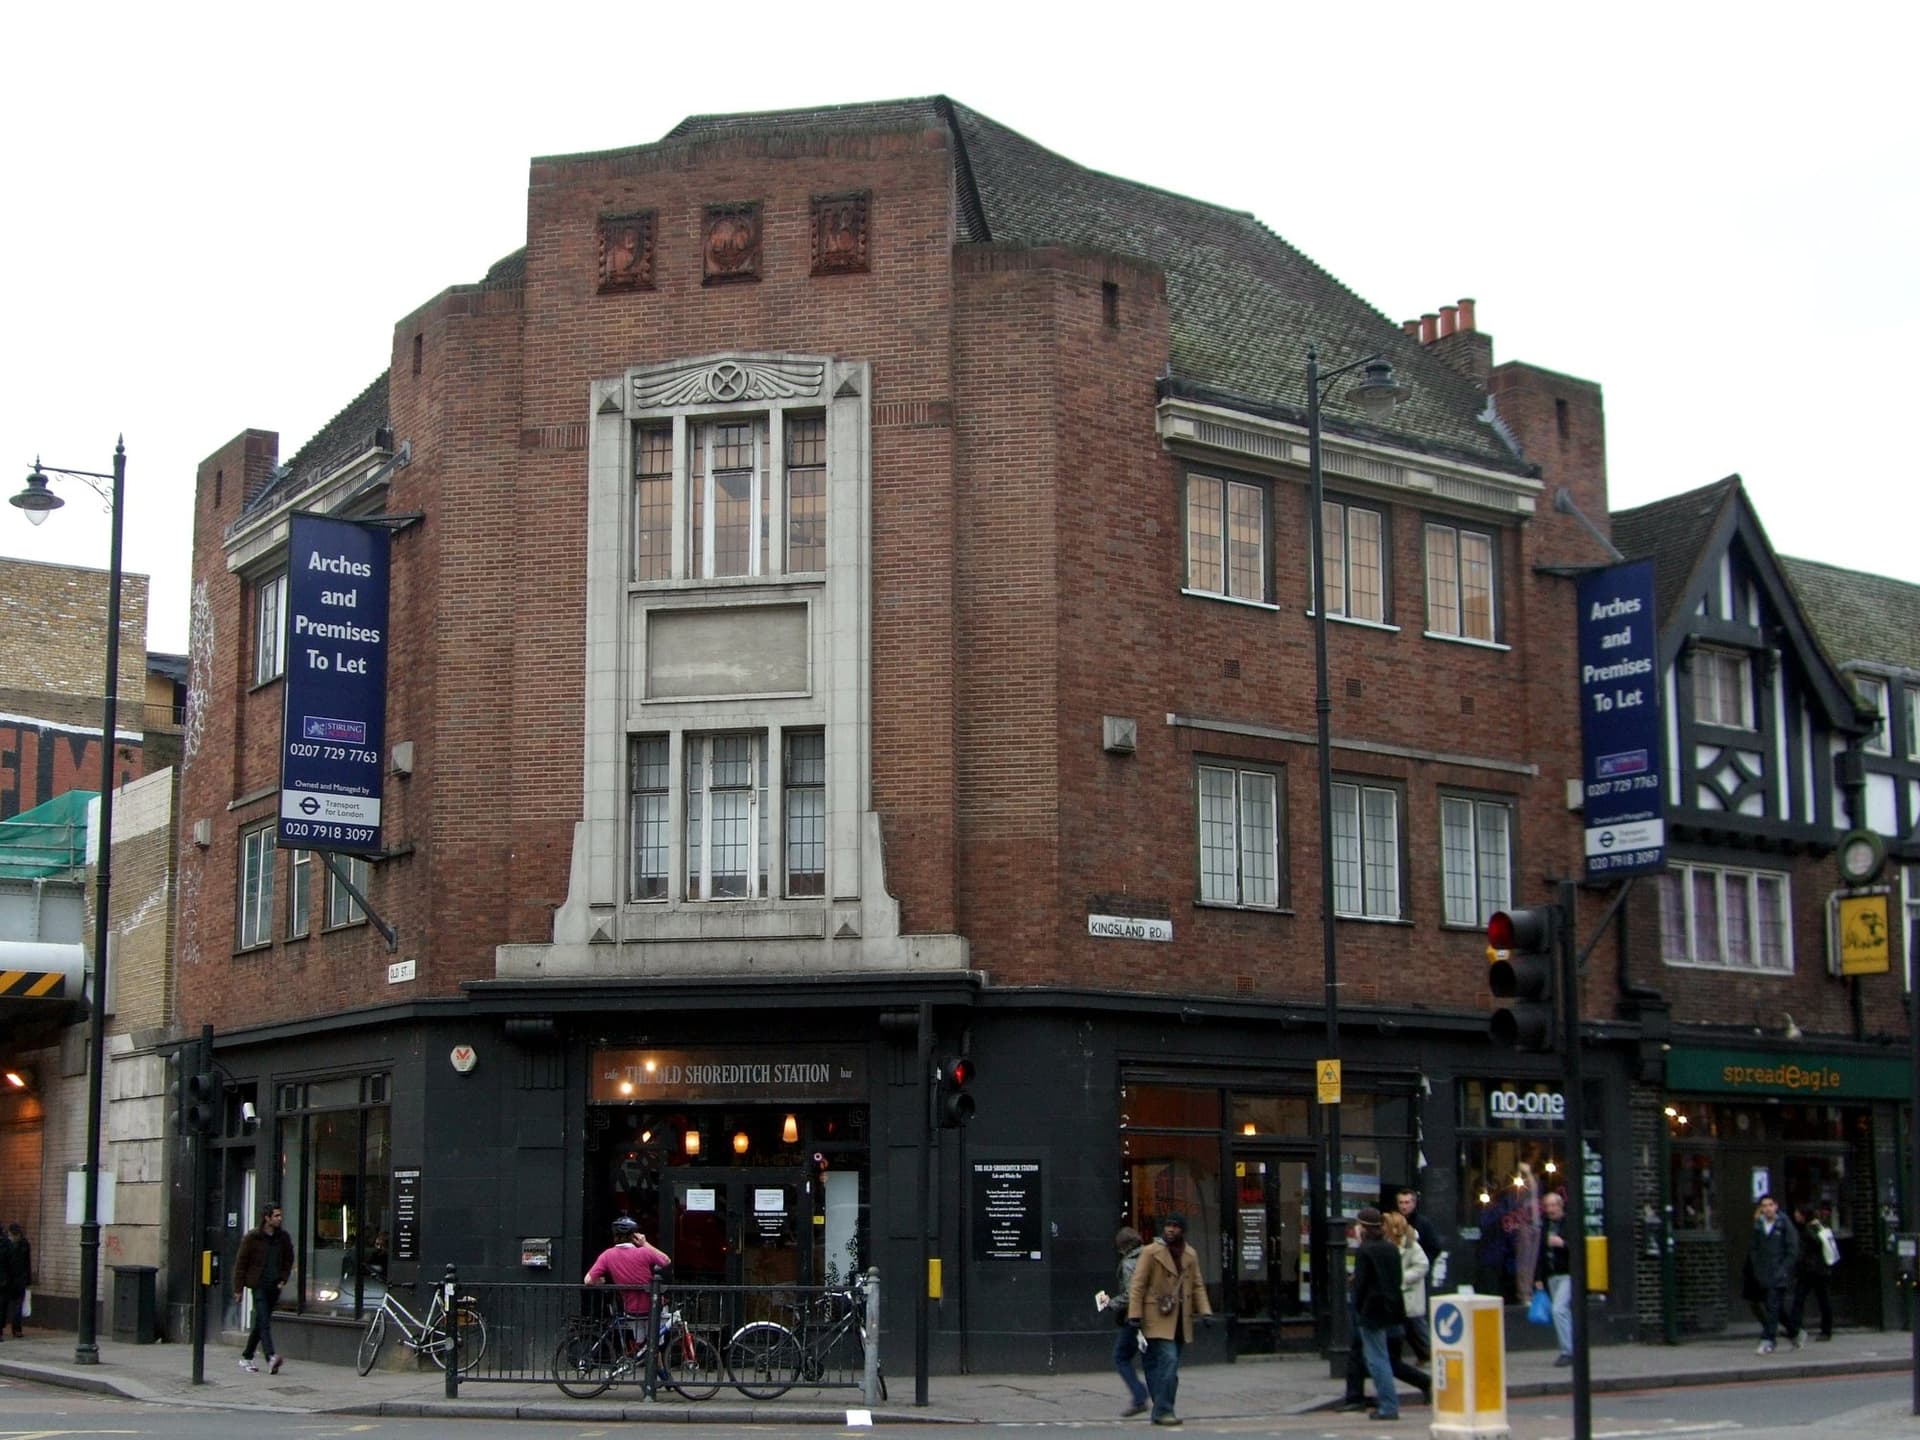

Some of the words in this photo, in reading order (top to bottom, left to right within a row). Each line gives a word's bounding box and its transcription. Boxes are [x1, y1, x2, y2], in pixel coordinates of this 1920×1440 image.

[308, 551, 372, 577] Arches
[320, 589, 357, 608] and
[1591, 597, 1641, 621] Arches
[295, 614, 380, 643] Premises
[1602, 626, 1631, 649] and
[307, 649, 328, 670] To
[336, 652, 367, 674] Let
[1583, 658, 1652, 684] Premises
[1594, 692, 1612, 712] To
[1616, 689, 1643, 709] Let
[327, 723, 363, 733] STIRLING
[290, 743, 320, 758] 0207
[323, 746, 345, 760] 729
[349, 749, 377, 764] 7763
[295, 780, 319, 789] Owned
[320, 782, 332, 790] and
[333, 783, 361, 794] Managed
[361, 785, 370, 795] by
[325, 808, 336, 816] for
[337, 809, 364, 819] London
[326, 800, 360, 811] Transport
[286, 822, 309, 836] 020
[312, 825, 341, 839] 7918
[345, 827, 374, 841] 3097
[1091, 921, 1145, 938] KINGSLAND
[625, 1066, 650, 1084] THE
[656, 1065, 682, 1084] OLD
[685, 1064, 770, 1084] SHOREDITCH
[774, 1063, 830, 1083] STATION
[840, 1067, 853, 1079] bar
[1490, 1090, 1564, 1113] no-one
